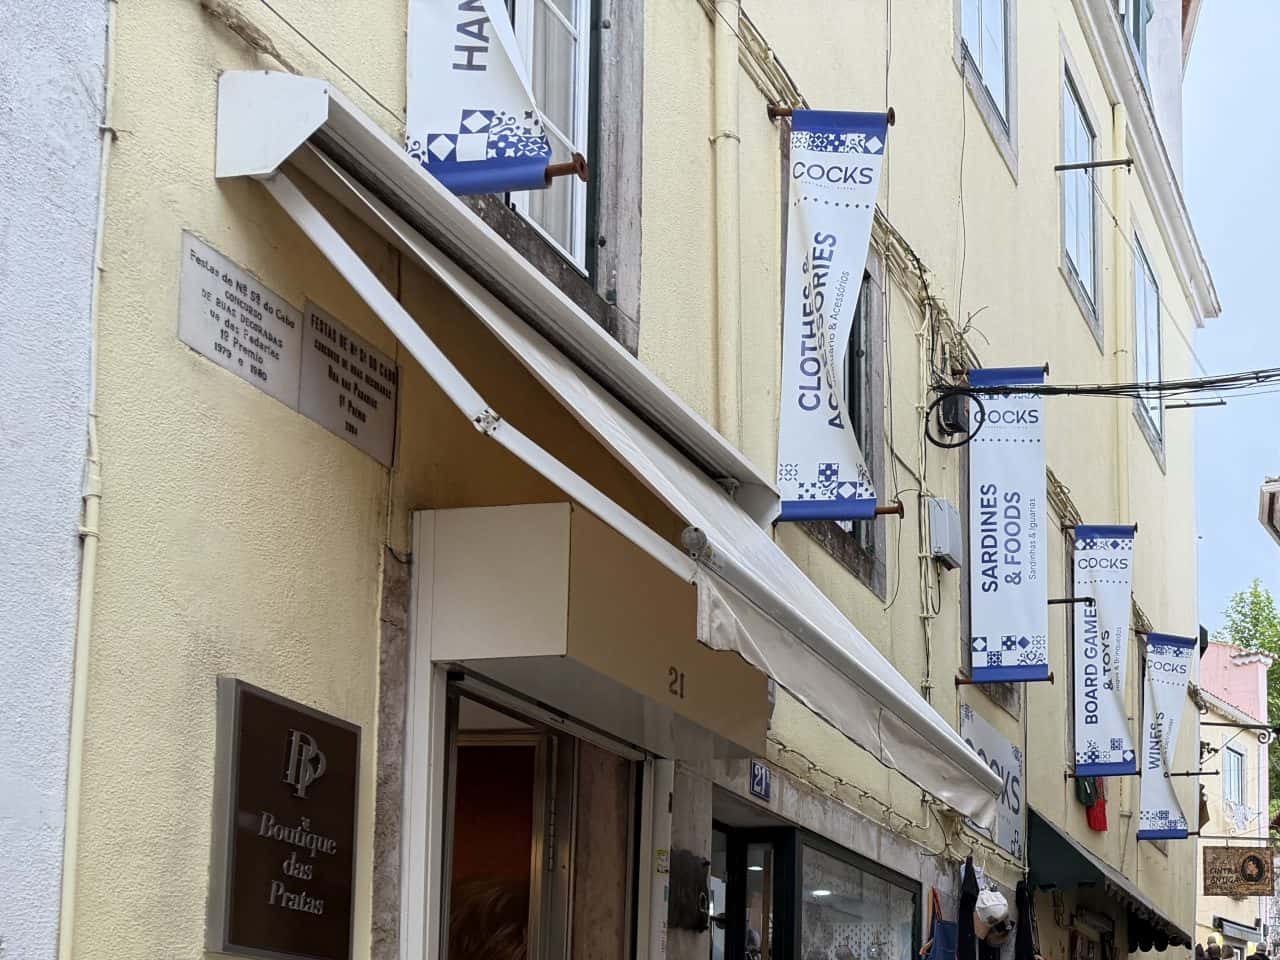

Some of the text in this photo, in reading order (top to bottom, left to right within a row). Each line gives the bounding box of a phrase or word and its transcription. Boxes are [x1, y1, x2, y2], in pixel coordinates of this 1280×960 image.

[792, 161, 875, 185] COCKS
[190, 248, 220, 278] Festas
[222, 272, 233, 287] de
[263, 302, 274, 315] do
[275, 310, 296, 329] Cabo
[224, 290, 263, 321] CONCURSO
[830, 270, 851, 321] Acessórios
[201, 288, 284, 349] DE RUAS DECORADAS
[224, 318, 240, 335] das
[311, 313, 337, 344] FESTAS
[829, 320, 838, 332] &
[213, 342, 268, 382] 1979 e 1980
[974, 409, 1040, 425] COCKS
[980, 483, 999, 593] SARDINES
[1004, 491, 1022, 586] & FOODS
[1029, 544, 1037, 581] Sardinhas
[1078, 557, 1129, 570] COCKS
[1102, 630, 1113, 690] & TOYS
[1147, 659, 1187, 674] COCKS
[668, 665, 685, 699] 21
[1085, 664, 1098, 725] BOARD
[258, 810, 337, 858] Boutique
[282, 851, 313, 881] das
[268, 879, 324, 916] Pratas
